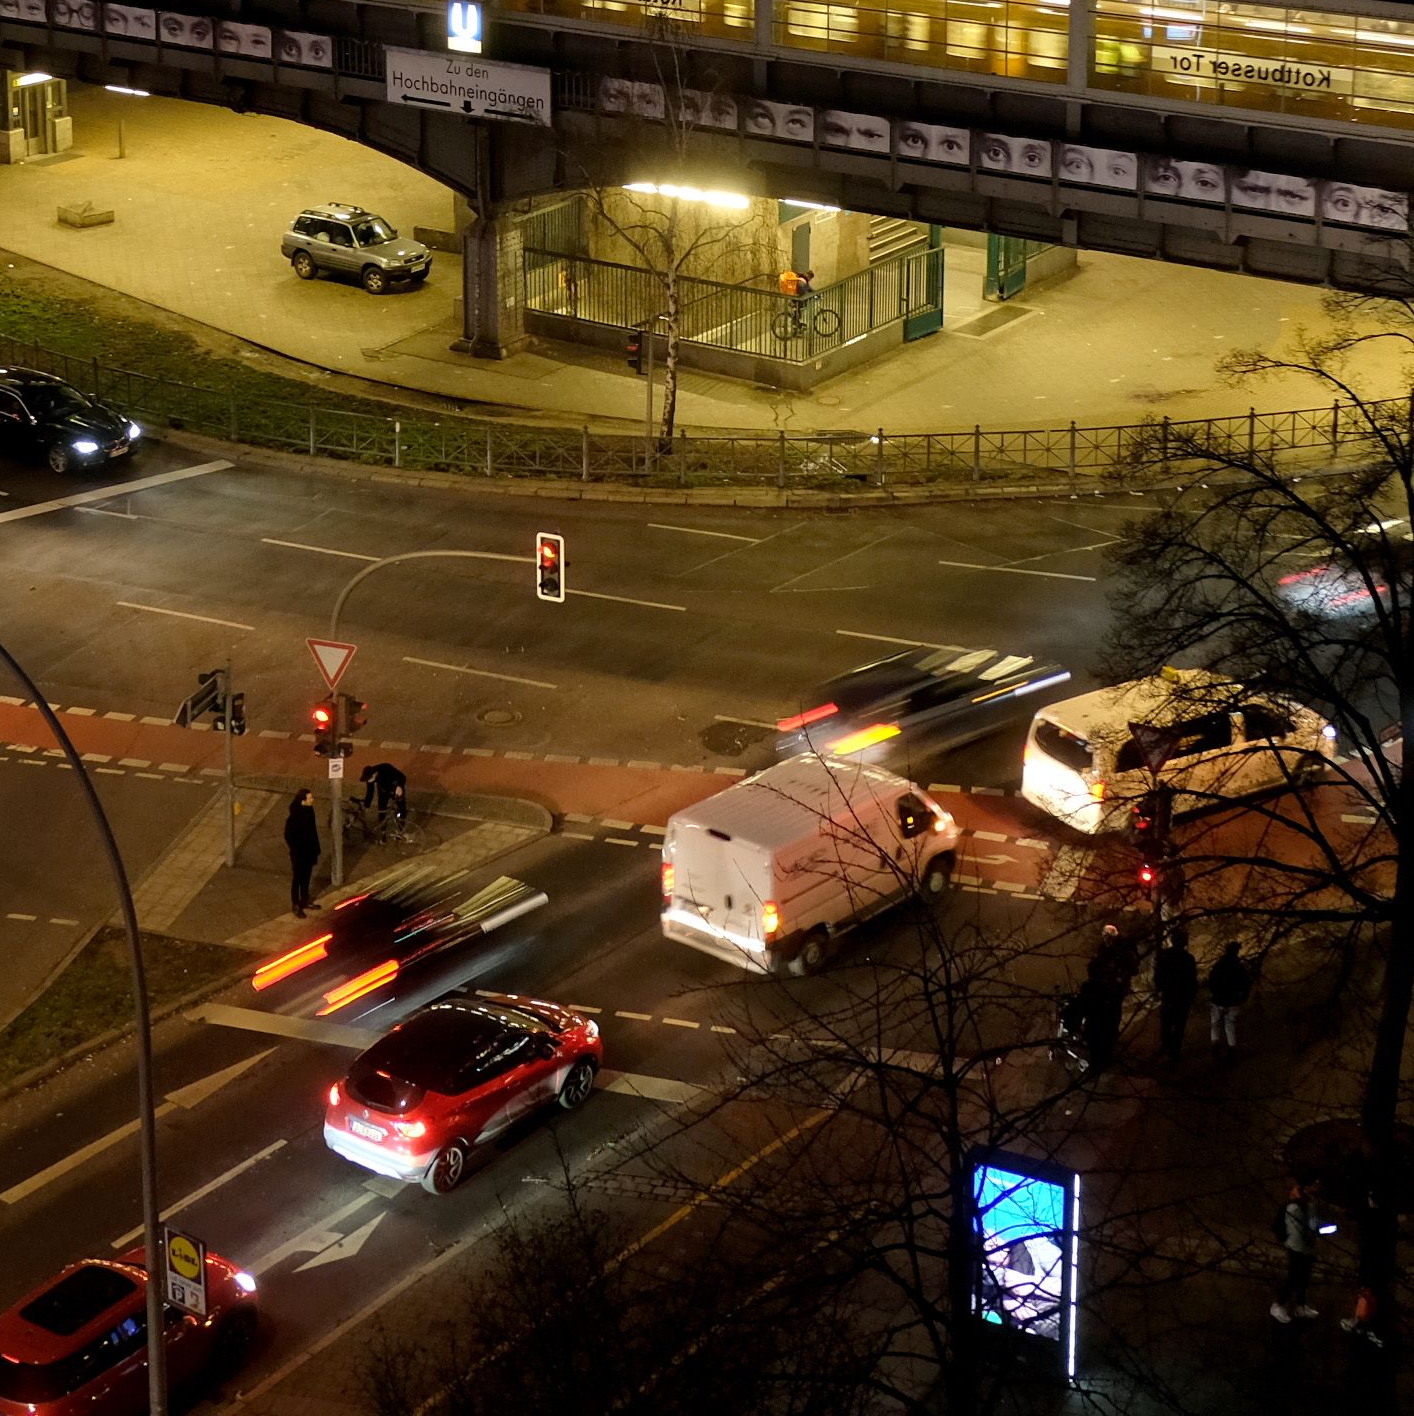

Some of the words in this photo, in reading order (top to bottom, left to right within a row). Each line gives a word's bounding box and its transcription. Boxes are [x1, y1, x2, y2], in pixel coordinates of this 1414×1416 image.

[451, 2, 478, 37] U
[446, 59, 461, 75] Zu
[466, 62, 489, 79] den
[392, 71, 544, 111] Hochbahneingängen
